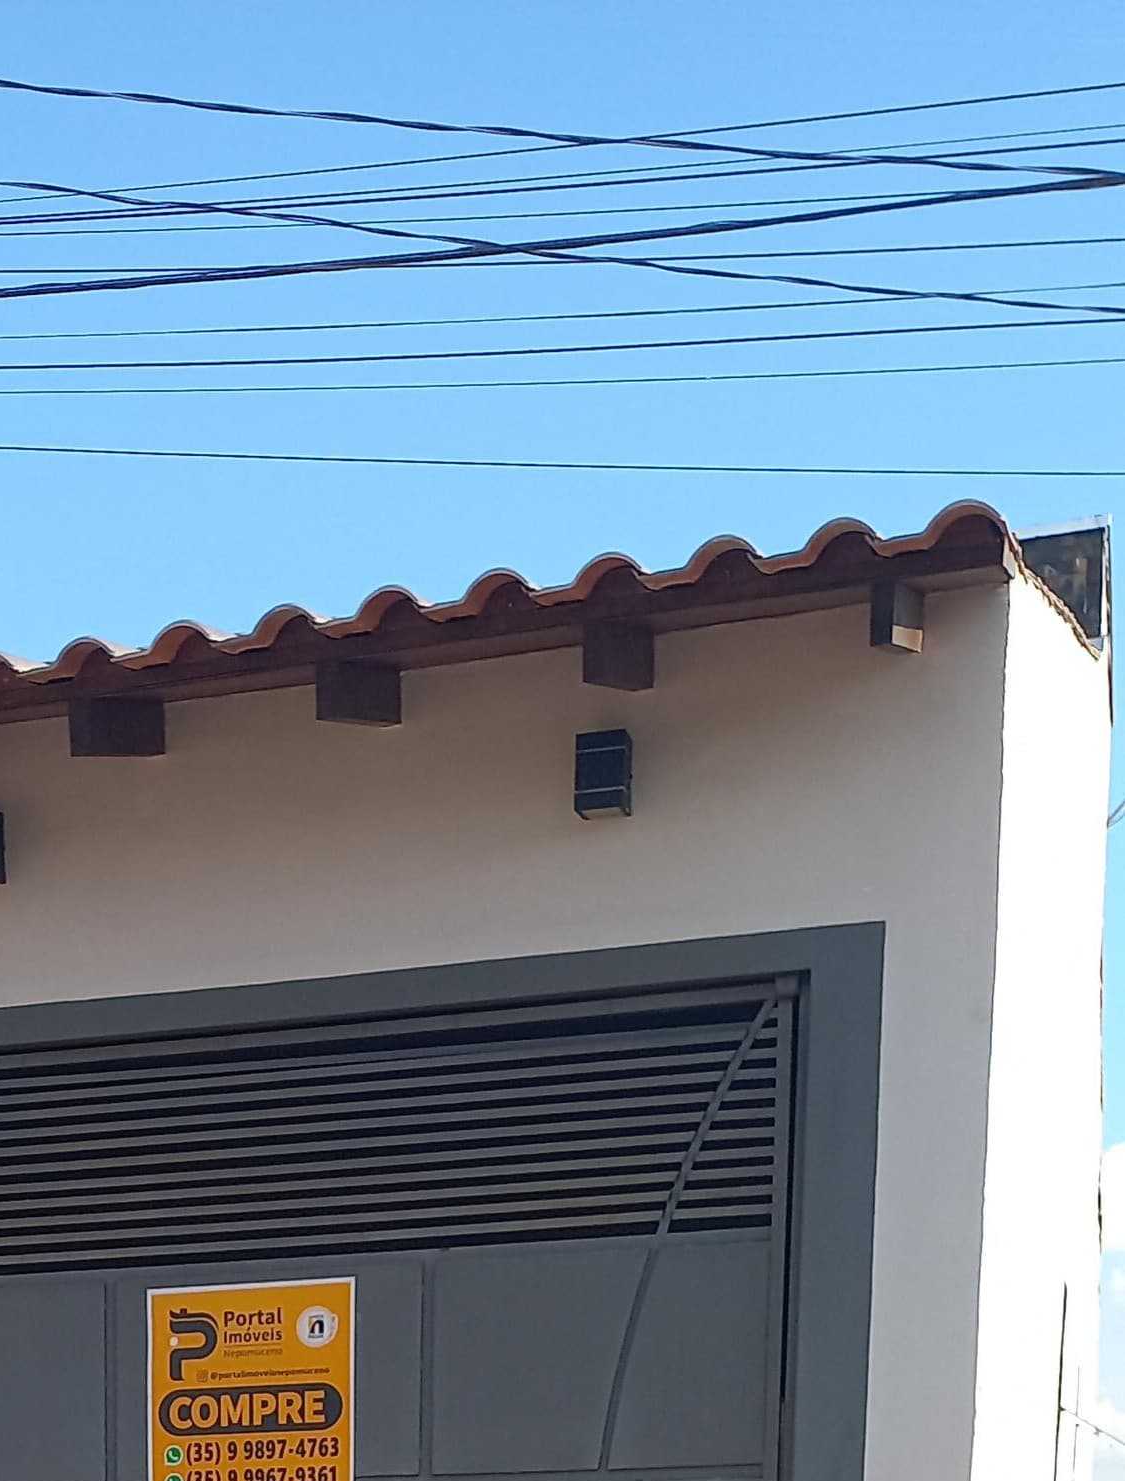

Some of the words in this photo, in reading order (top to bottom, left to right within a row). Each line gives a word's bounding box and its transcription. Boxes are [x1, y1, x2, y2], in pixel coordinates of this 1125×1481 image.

[223, 1307, 283, 1328] Portal
[223, 1327, 283, 1344] Imóveis
[223, 1348, 283, 1358] Nepomuceno
[169, 1390, 325, 1429] COMPRE
[186, 1441, 221, 1466] (35)
[227, 1441, 238, 1461] 9
[243, 1437, 339, 1461] 9897-4763
